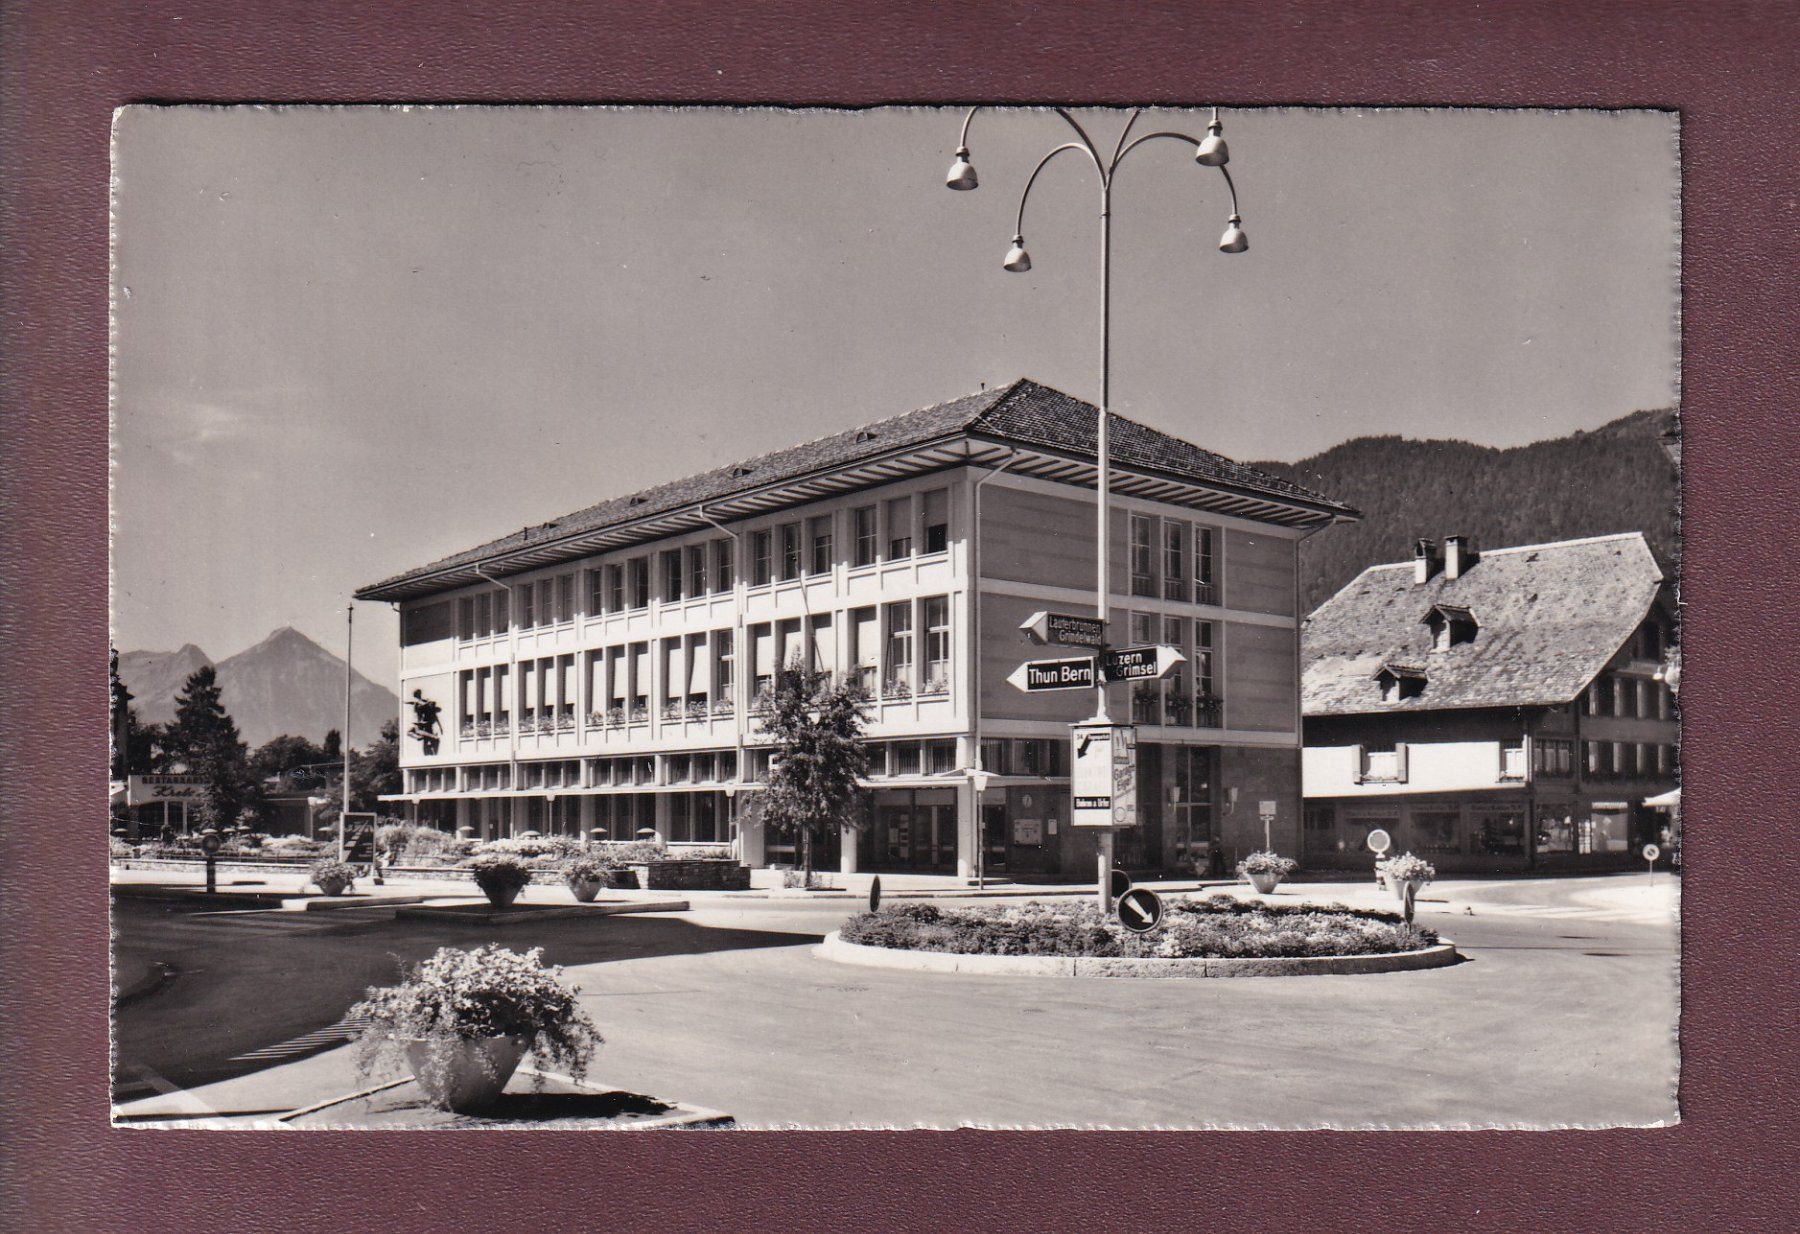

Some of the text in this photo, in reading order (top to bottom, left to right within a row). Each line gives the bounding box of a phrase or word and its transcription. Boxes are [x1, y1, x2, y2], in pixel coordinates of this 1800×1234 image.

[1049, 616, 1101, 633] Lauterbrunnen
[1059, 629, 1102, 646] Grindelwald
[1028, 665, 1091, 684] Thun Bern
[1116, 661, 1158, 677] Grimsel
